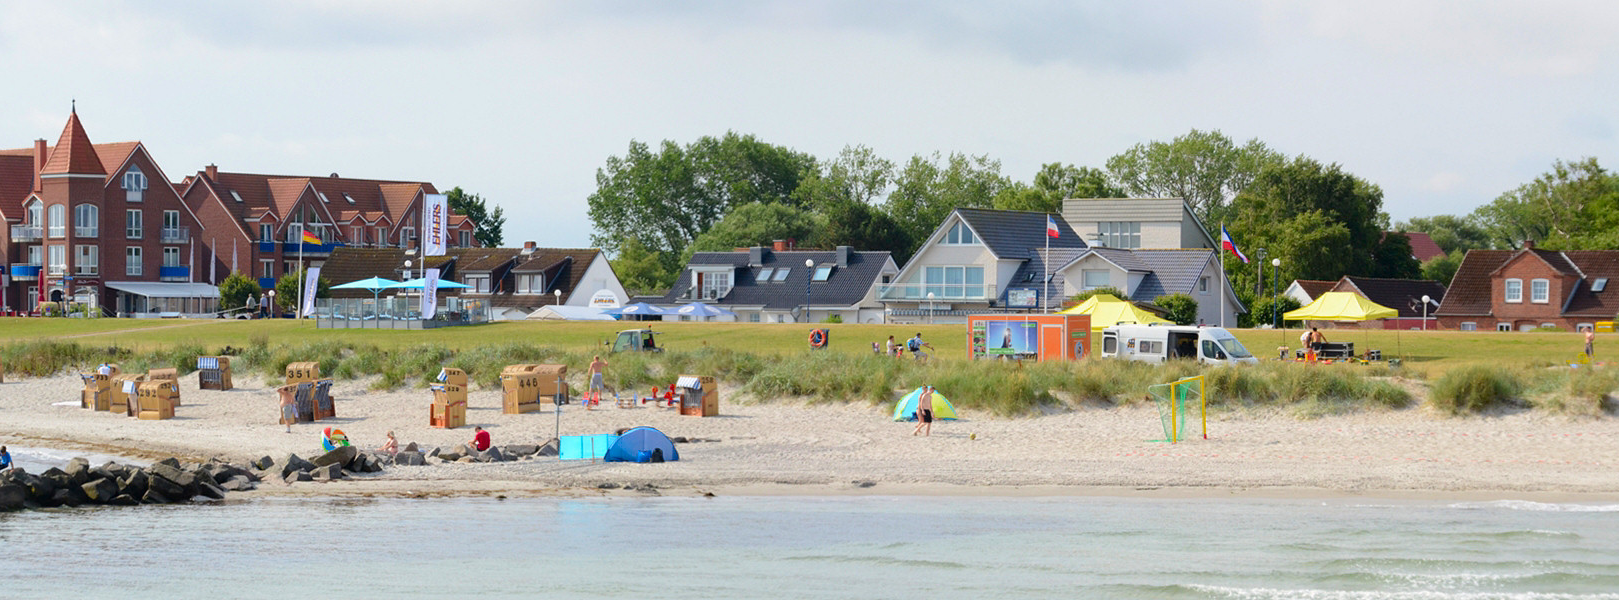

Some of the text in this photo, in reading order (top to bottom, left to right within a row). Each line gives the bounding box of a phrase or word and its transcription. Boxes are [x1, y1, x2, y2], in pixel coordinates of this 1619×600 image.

[433, 203, 441, 246] EHLERS
[288, 370, 310, 379] 351
[519, 377, 538, 388] 446
[139, 388, 157, 398] 292
